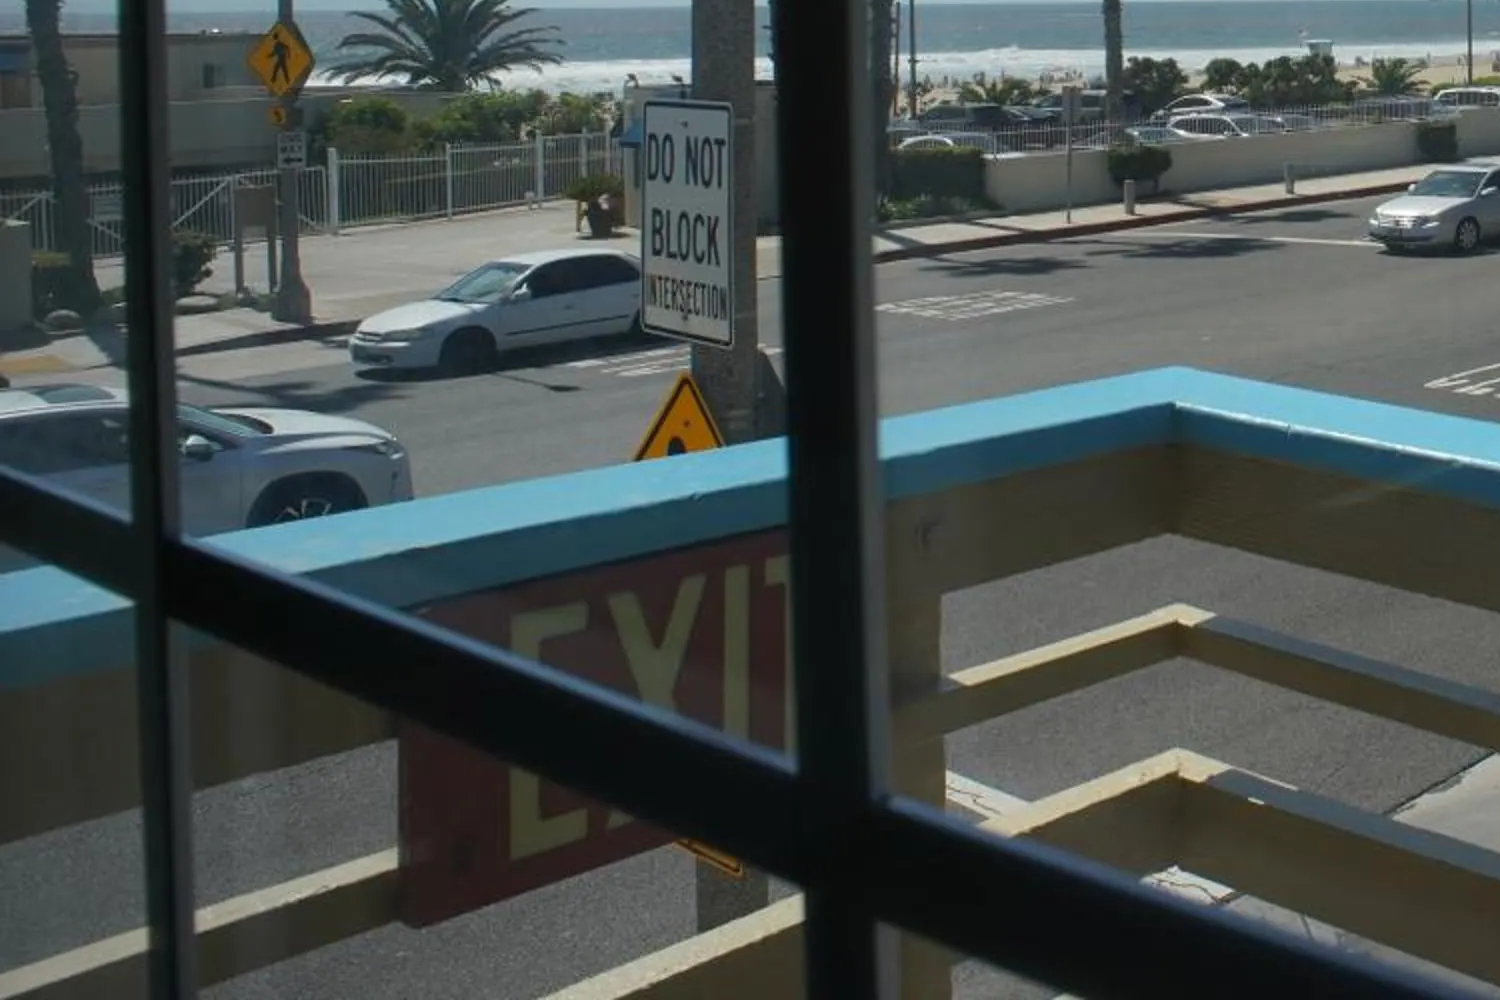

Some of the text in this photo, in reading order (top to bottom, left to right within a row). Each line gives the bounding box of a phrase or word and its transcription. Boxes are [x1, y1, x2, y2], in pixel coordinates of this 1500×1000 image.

[648, 132, 727, 190] DO NOT
[652, 207, 720, 267] BLOCK
[646, 272, 728, 321] INTERSECTION
